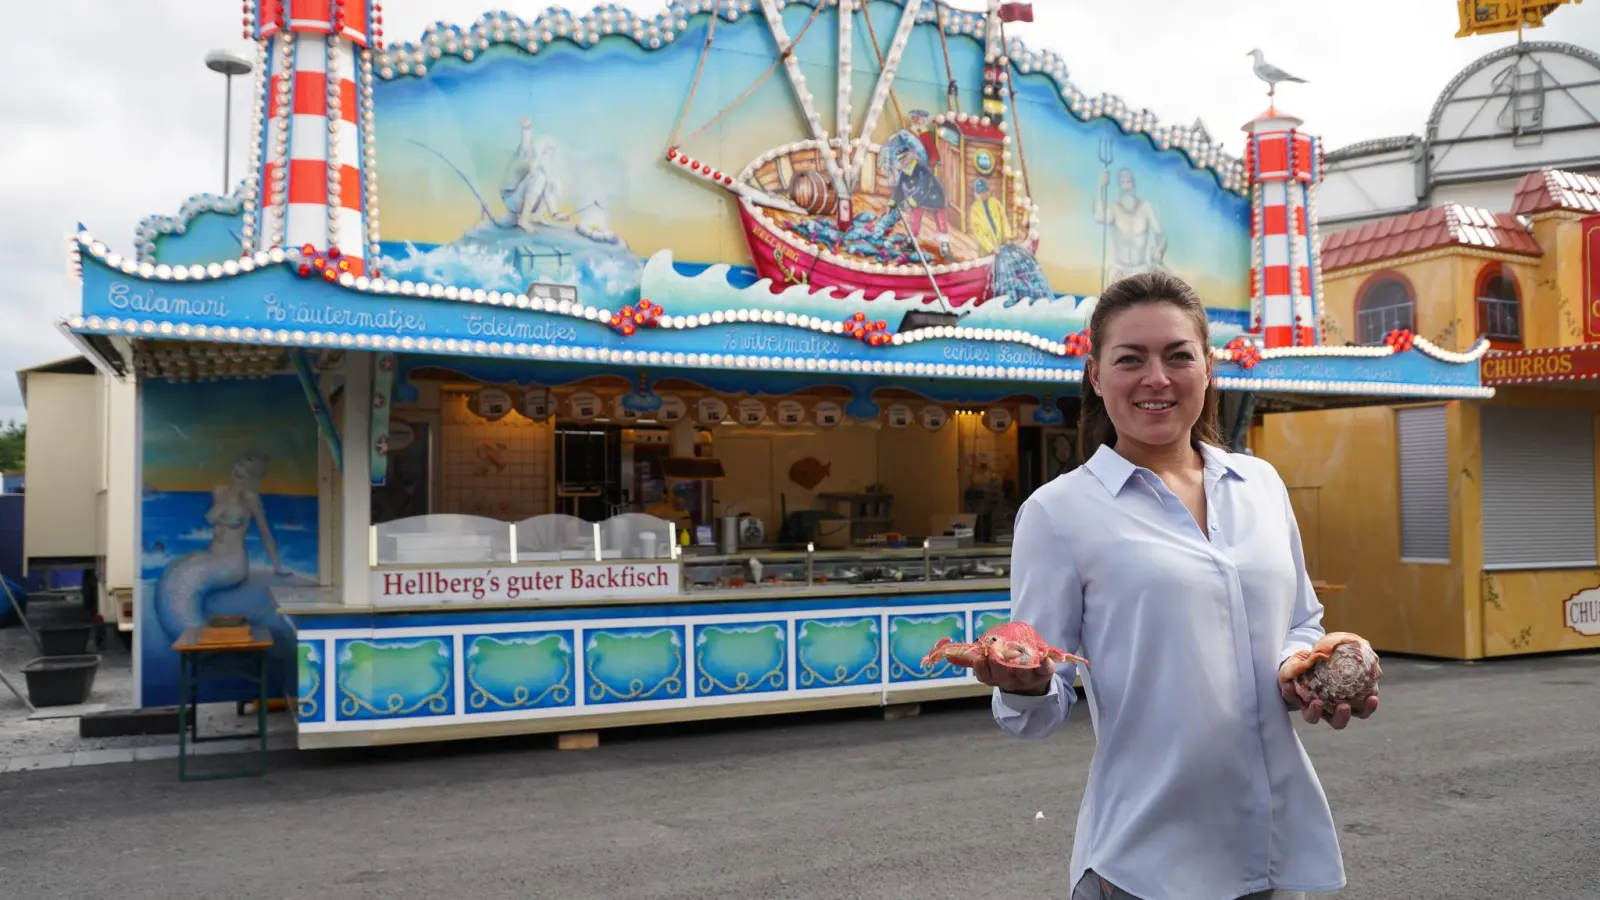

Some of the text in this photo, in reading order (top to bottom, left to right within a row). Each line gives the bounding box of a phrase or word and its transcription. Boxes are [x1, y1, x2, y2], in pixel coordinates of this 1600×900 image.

[108, 281, 230, 317] Calamari
[263, 292, 427, 333] Kräutermatjes
[462, 312, 577, 344] Edelmatjes
[1483, 354, 1572, 378] CHURROS
[507, 575, 564, 599] guter
[570, 565, 669, 590] Backfisch
